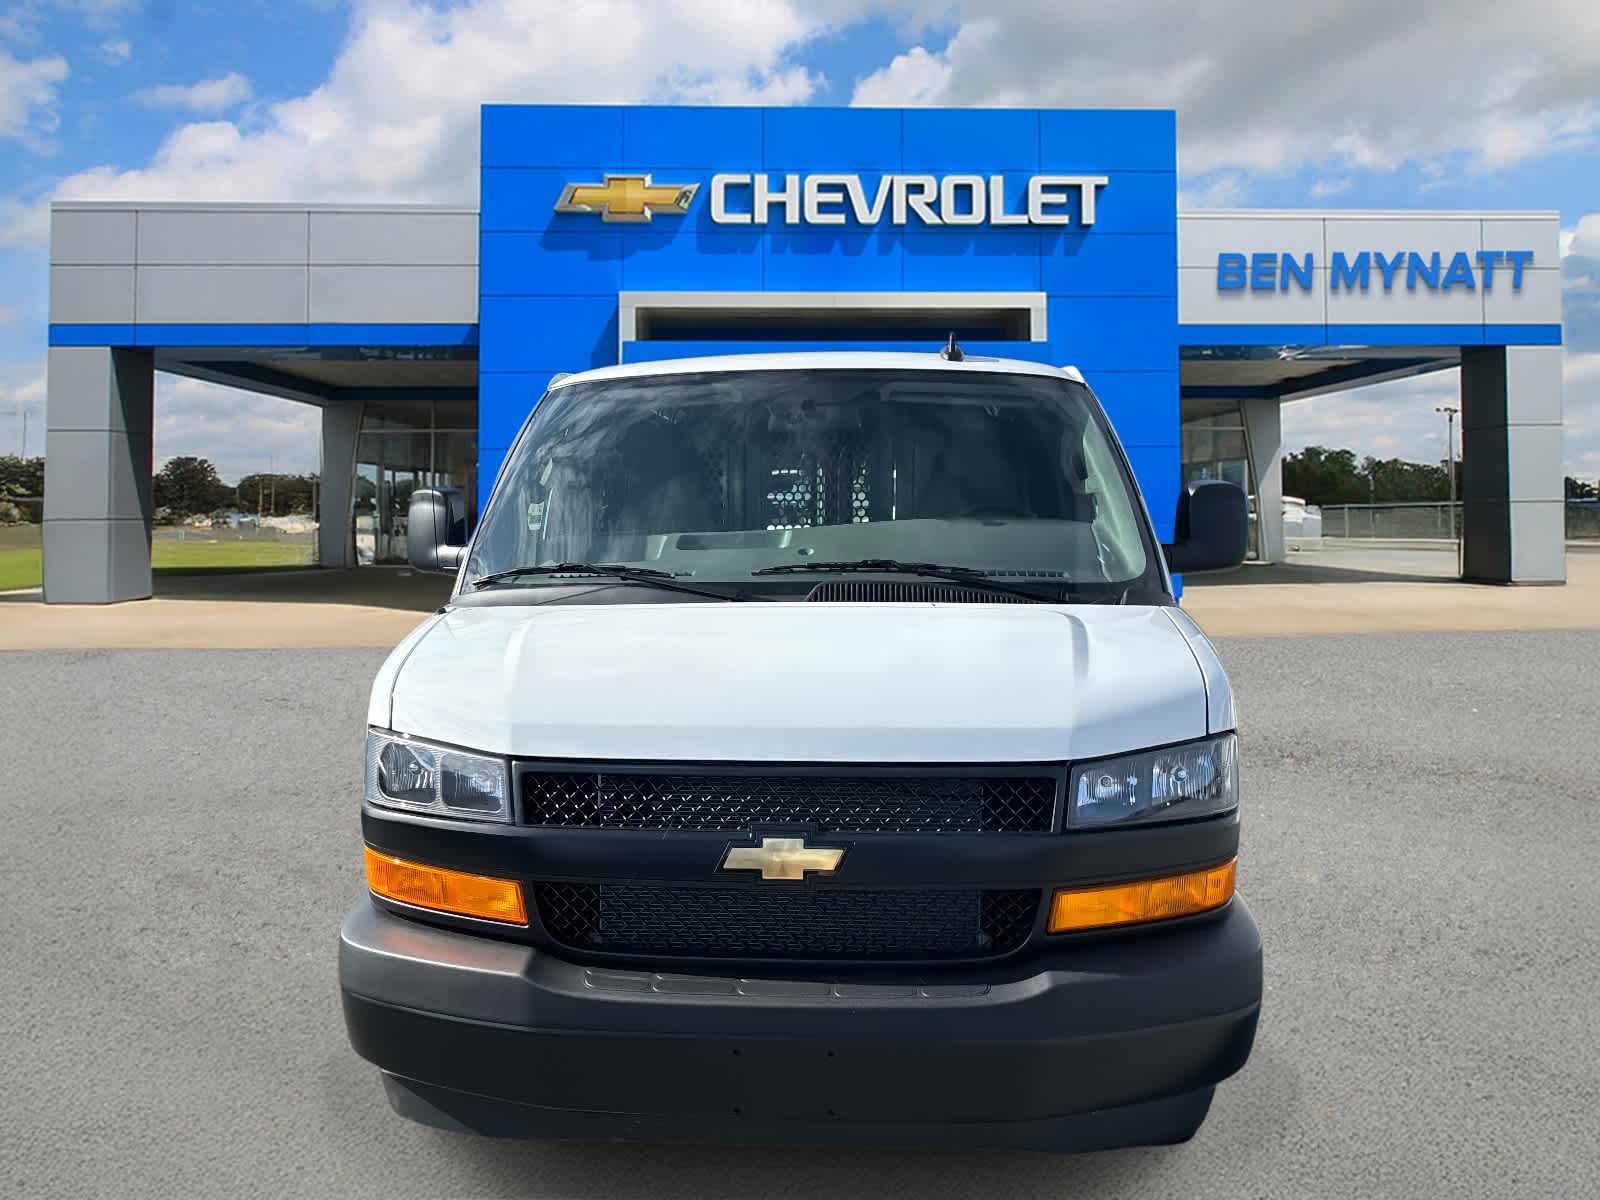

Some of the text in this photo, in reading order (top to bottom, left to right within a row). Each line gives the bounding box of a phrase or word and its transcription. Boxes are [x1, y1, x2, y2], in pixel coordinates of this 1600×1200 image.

[710, 173, 1109, 225] CHEVROLET
[1217, 250, 1534, 291] BEN MYNATT
